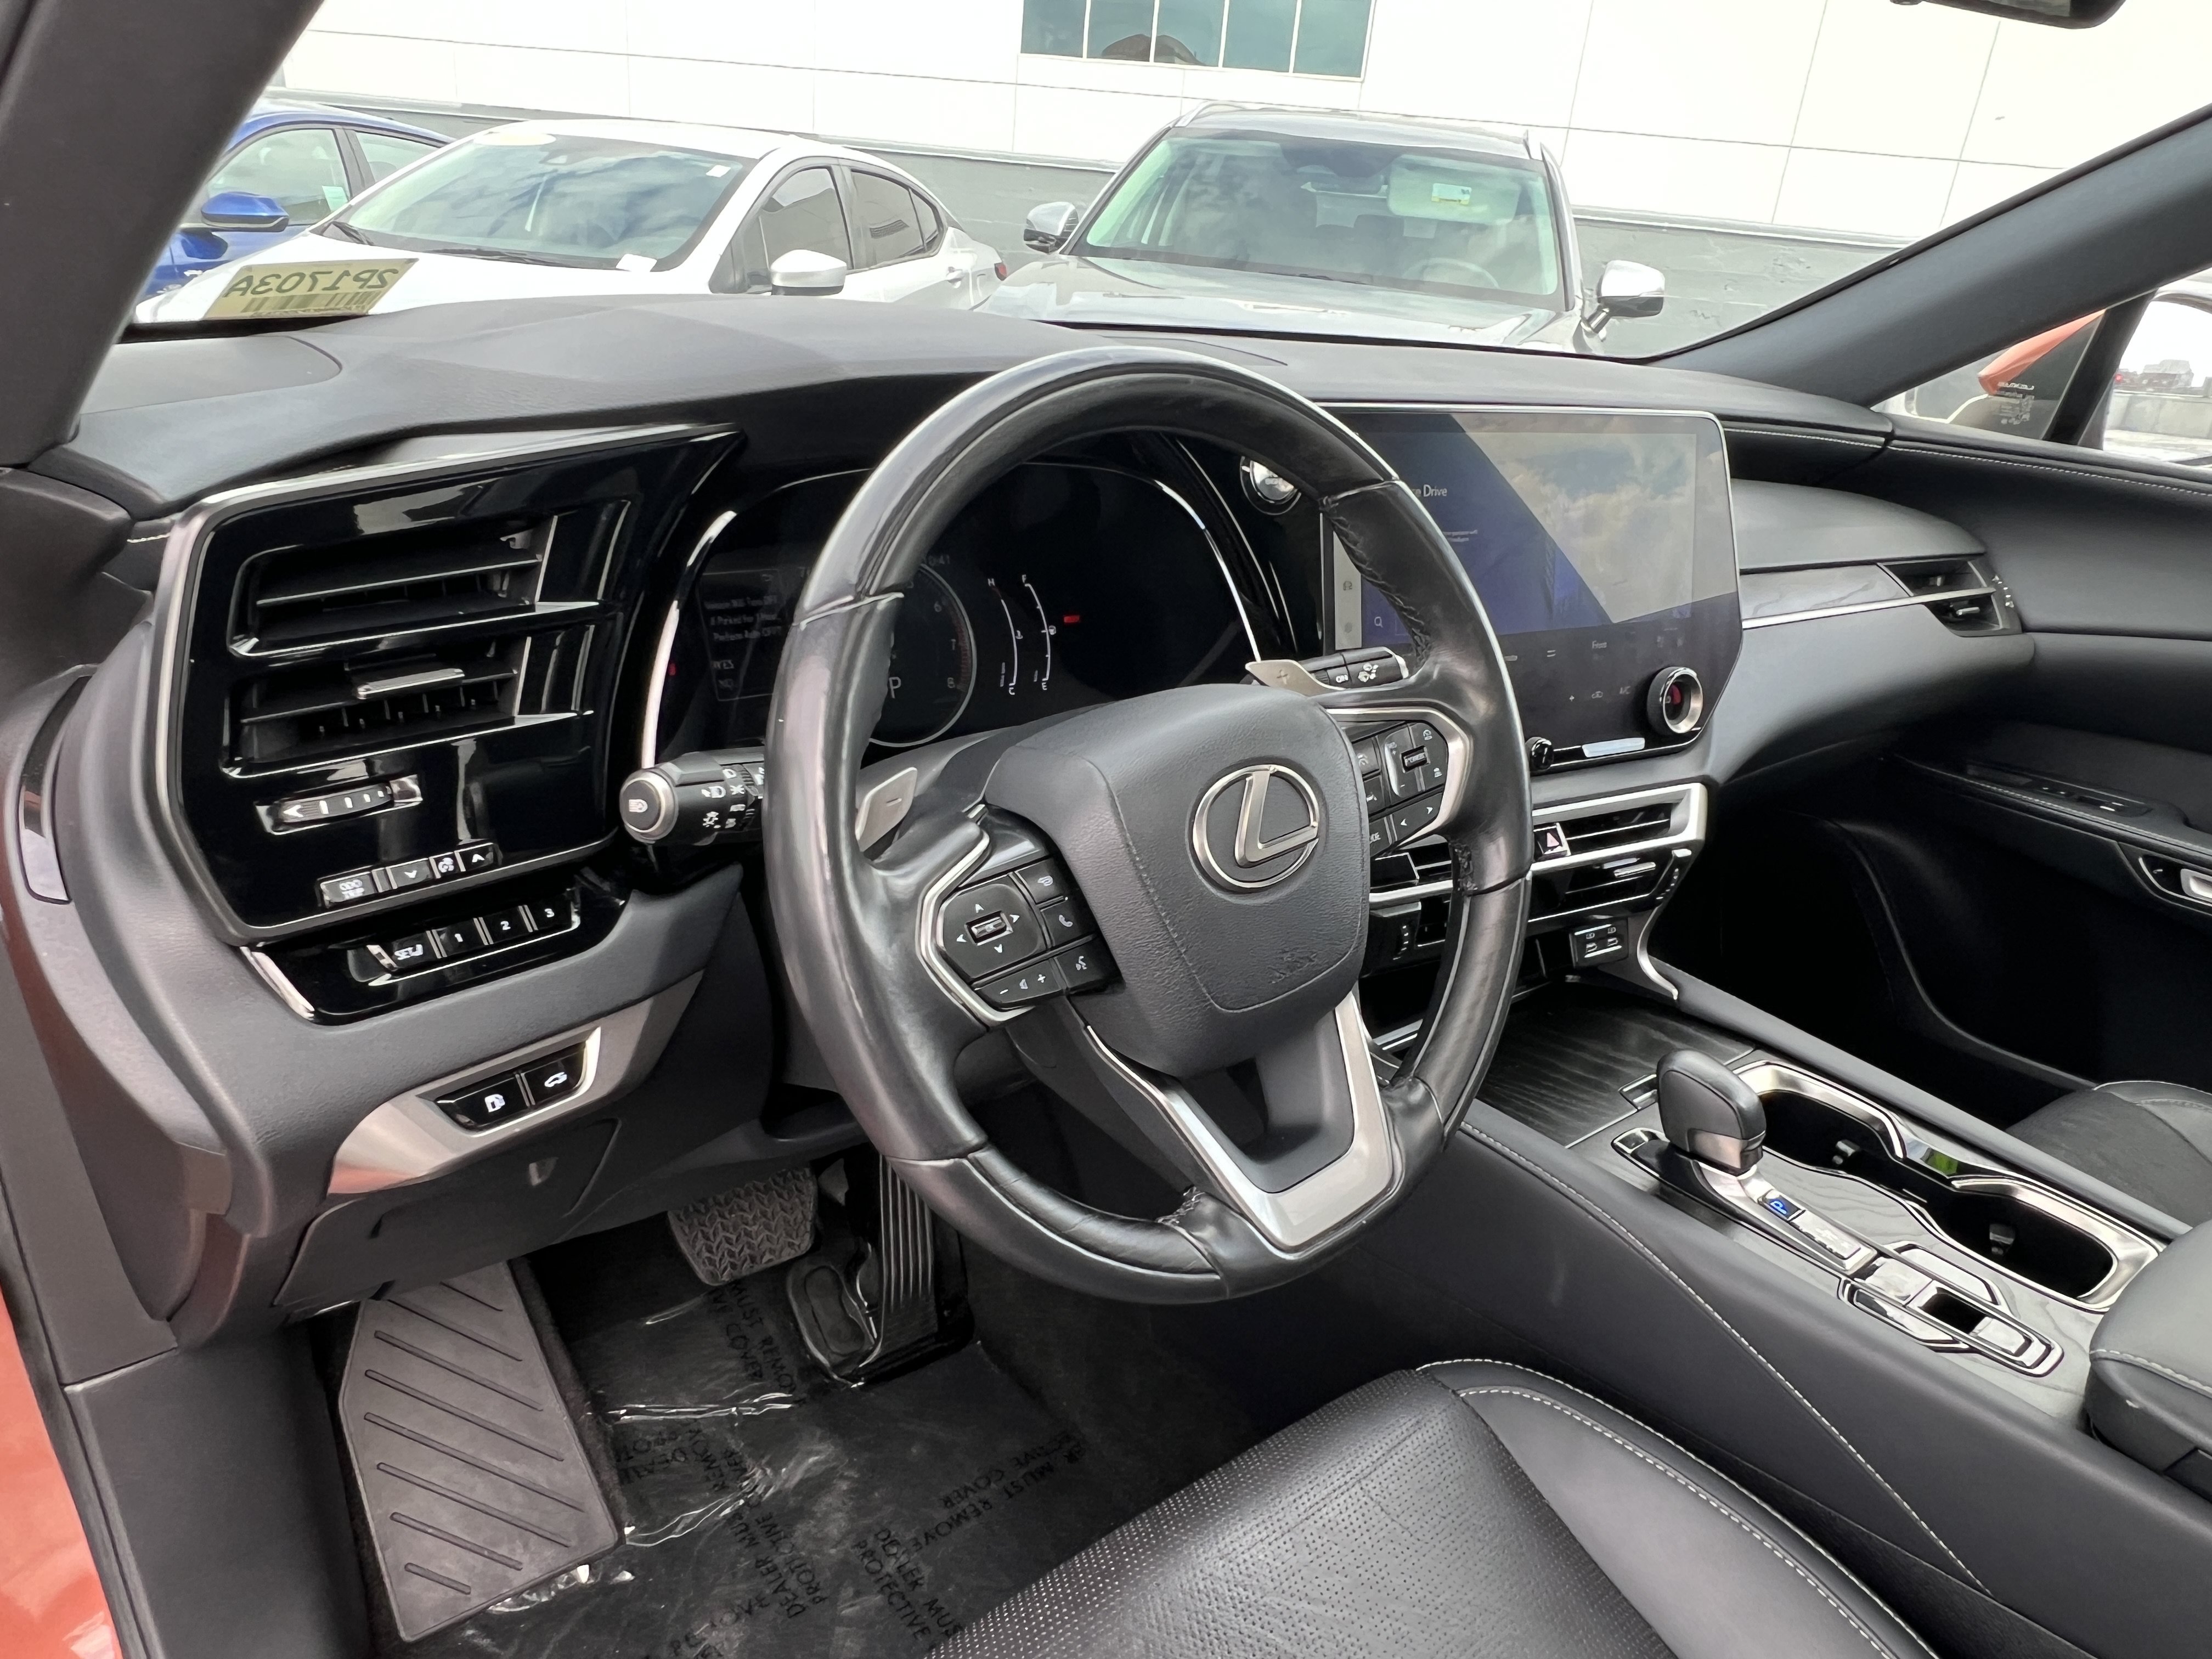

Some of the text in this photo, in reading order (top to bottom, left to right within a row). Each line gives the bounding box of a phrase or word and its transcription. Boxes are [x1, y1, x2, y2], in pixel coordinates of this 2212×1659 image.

[1423, 484, 1448, 497] Drive
[889, 676, 901, 699] P
[454, 908, 555, 943] 1 2 3
[1770, 1200, 1787, 1215] P
[910, 1498, 993, 1554] REMOVE
[755, 1555, 806, 1619] DEALER
[851, 1539, 932, 1641] PROTECTIVE
[923, 1597, 964, 1638] MUS
